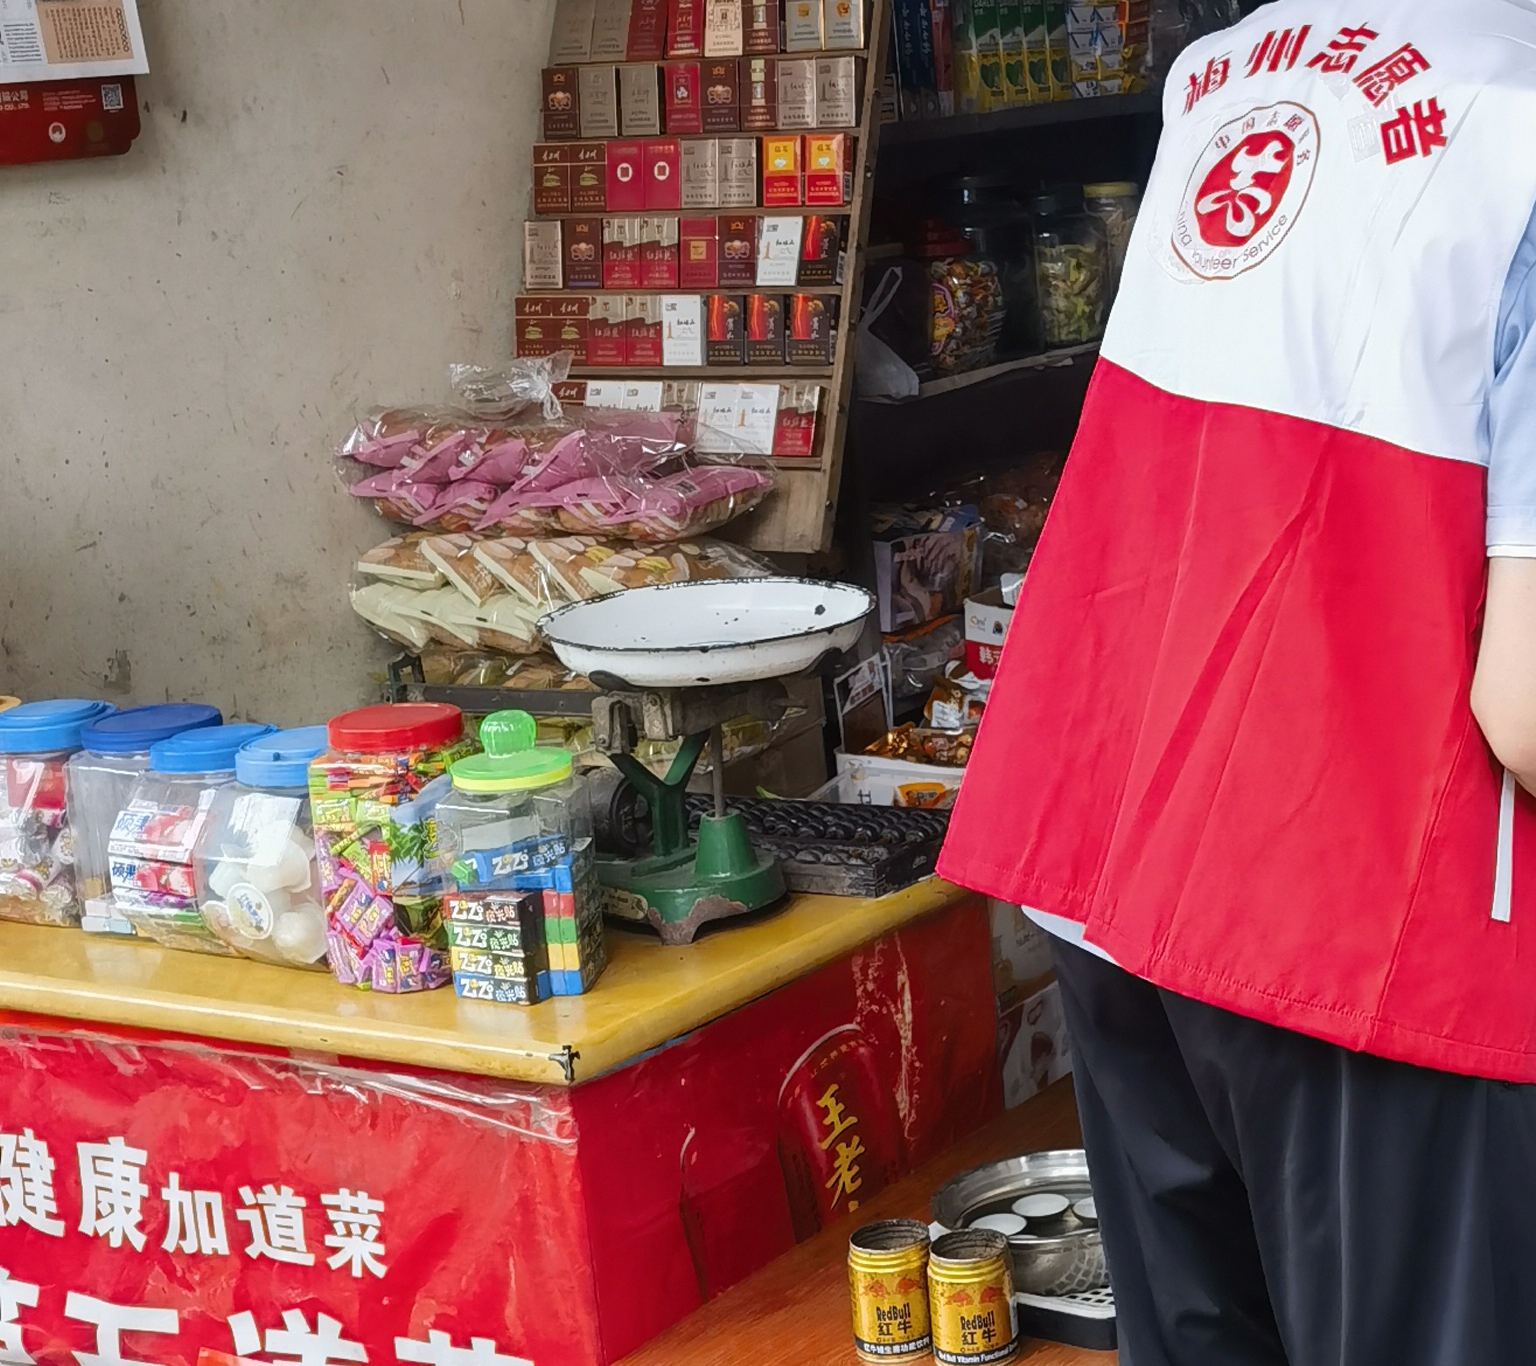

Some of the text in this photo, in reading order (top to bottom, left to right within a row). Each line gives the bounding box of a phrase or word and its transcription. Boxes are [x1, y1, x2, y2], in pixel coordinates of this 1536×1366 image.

[1214, 110, 1313, 168] 中国志愿务
[1242, 214, 1288, 263] Service
[814, 1082, 867, 1213] 王老
[0, 1127, 389, 1280] 健康加道菜
[876, 1318, 913, 1337] 红牛
[960, 1309, 996, 1331] RedBull
[961, 1327, 997, 1347] 红牛
